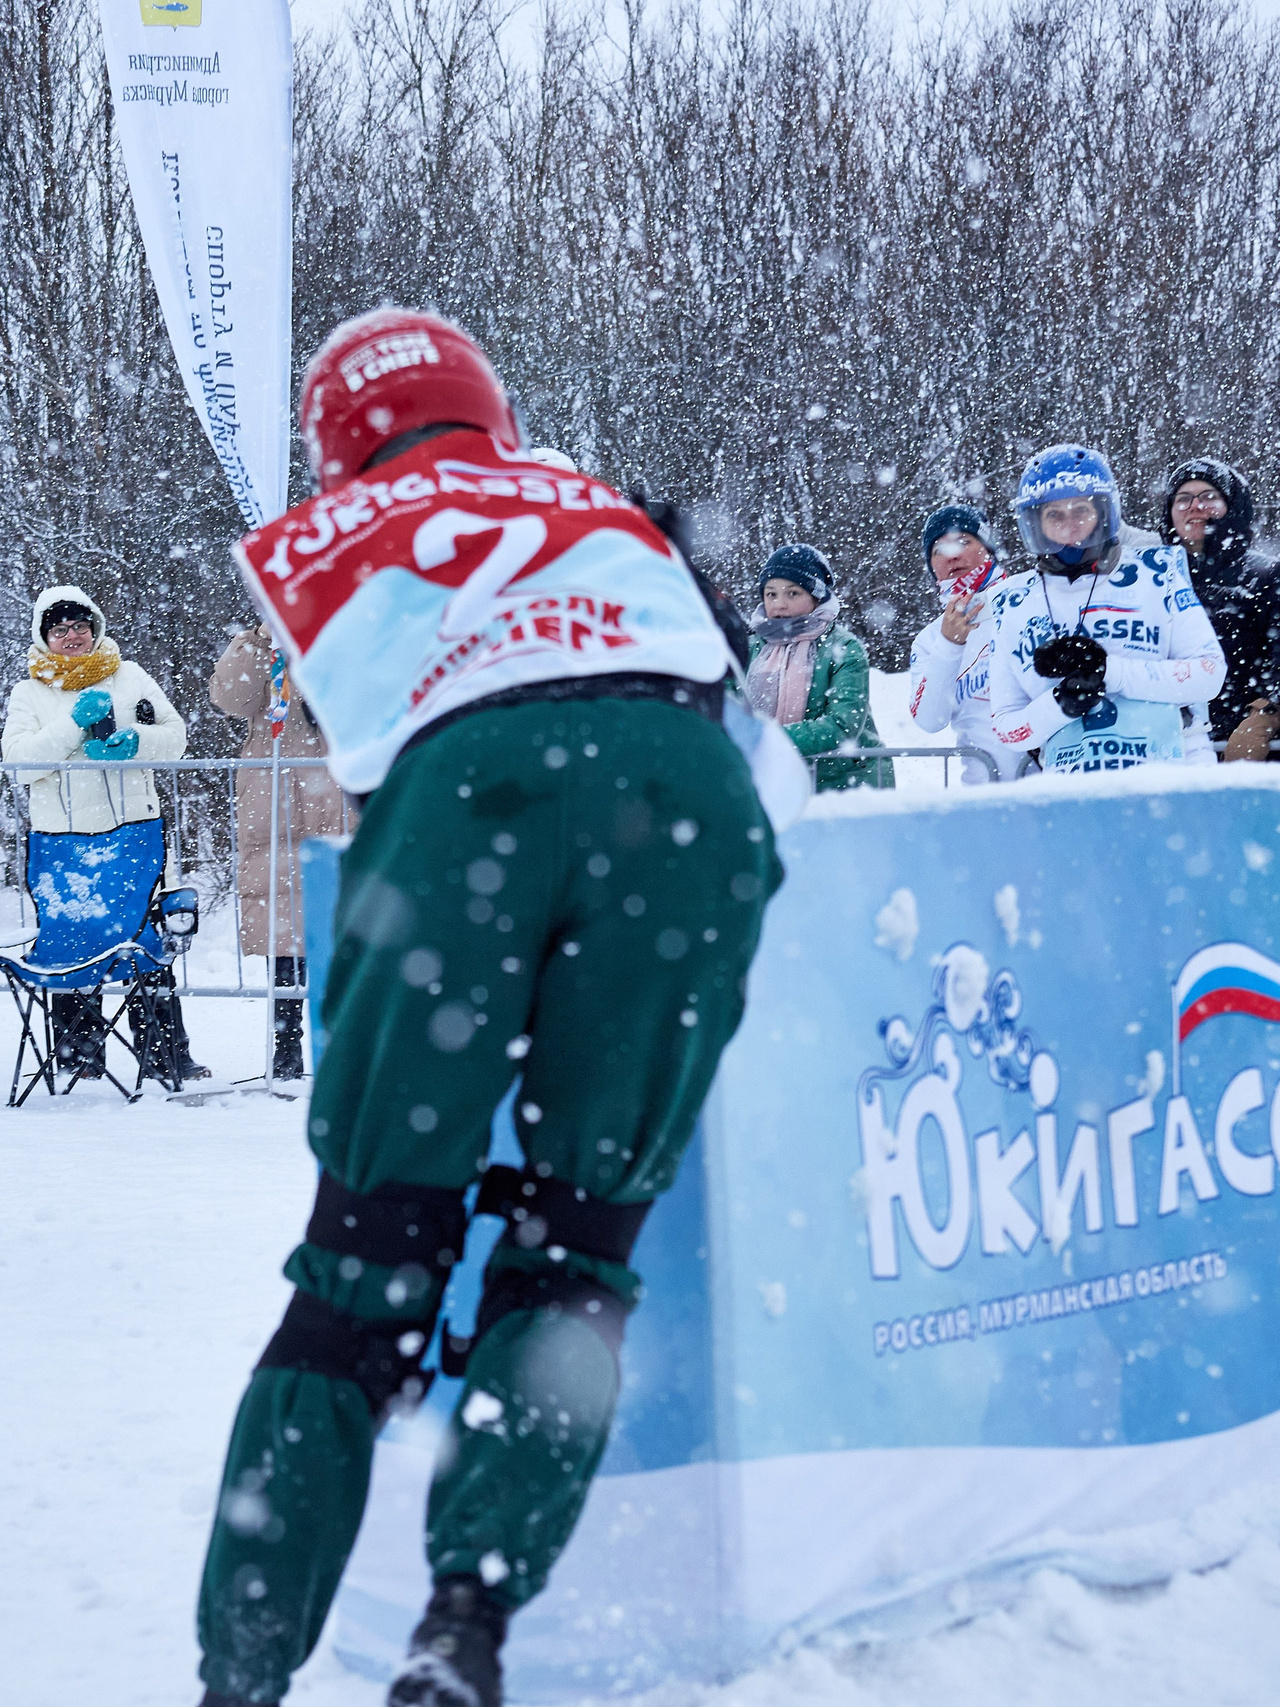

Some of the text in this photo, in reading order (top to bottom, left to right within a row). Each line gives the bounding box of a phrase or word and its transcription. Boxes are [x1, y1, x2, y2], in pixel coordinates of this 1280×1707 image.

[412, 507, 547, 641] 2
[1088, 740, 1148, 758] ТОЛК
[977, 1271, 1135, 1336] МУРМАНСКАЯ
[1135, 1250, 1228, 1299] ОБЛАСТЬ
